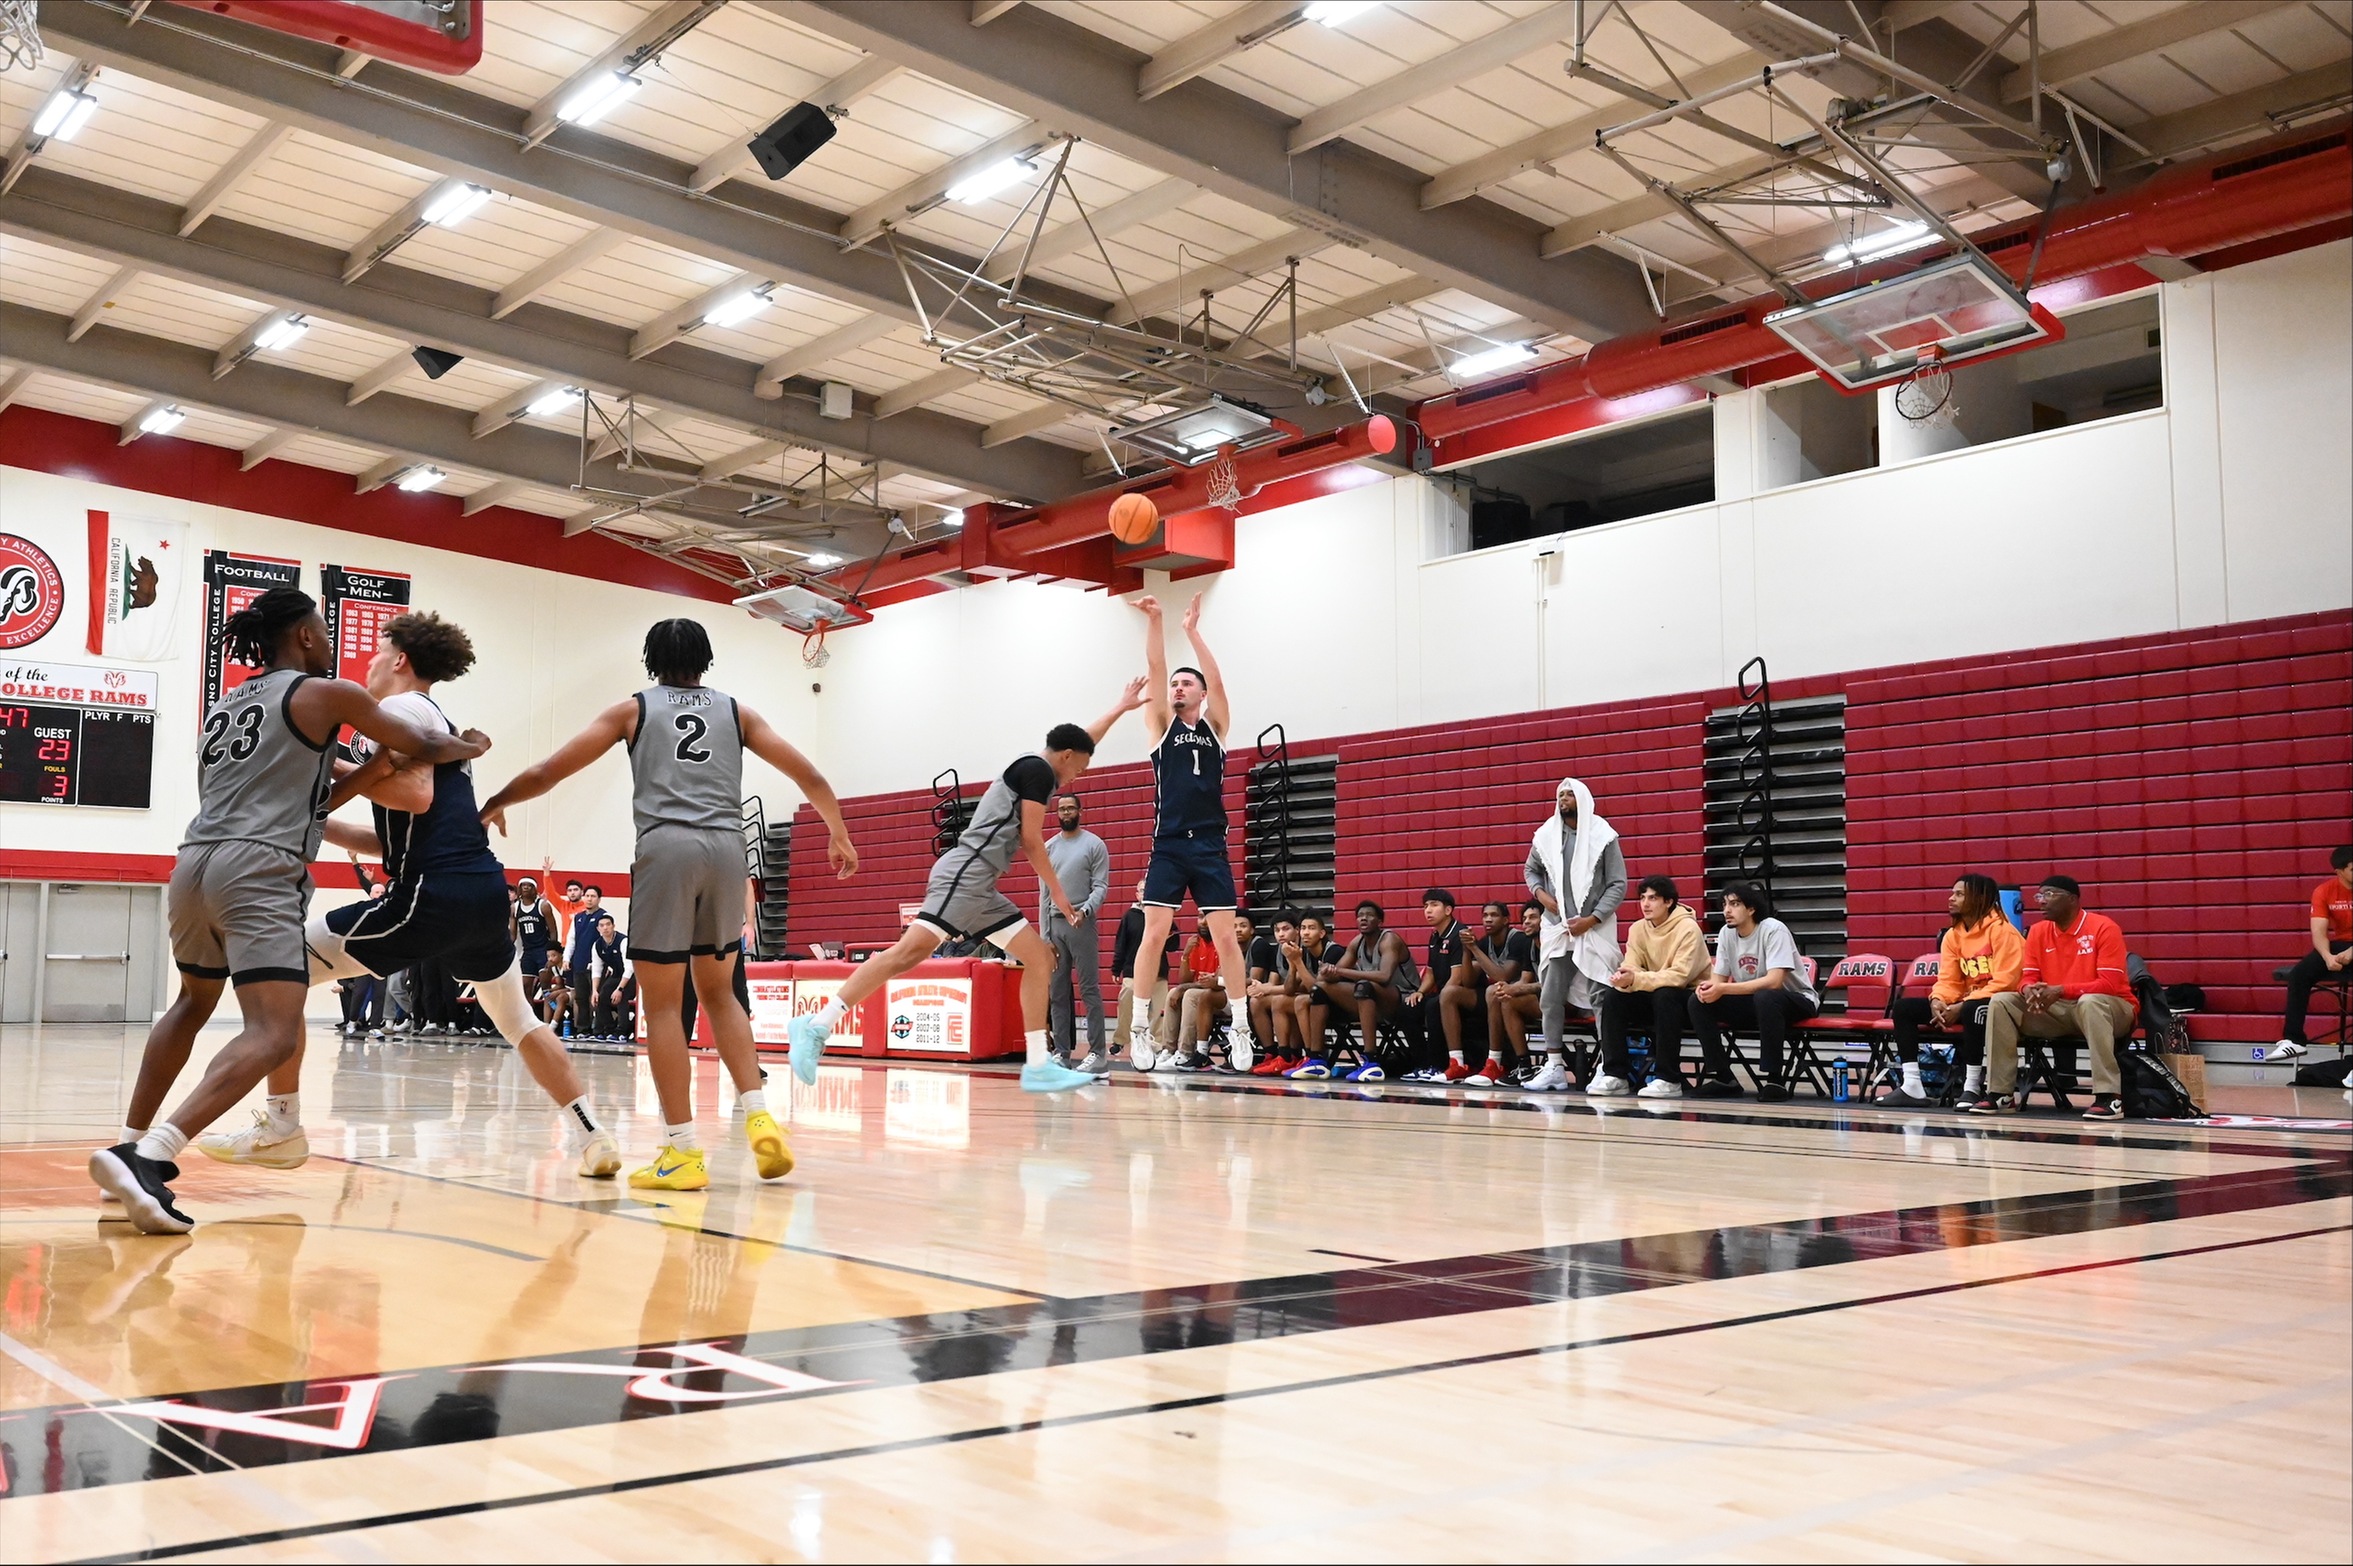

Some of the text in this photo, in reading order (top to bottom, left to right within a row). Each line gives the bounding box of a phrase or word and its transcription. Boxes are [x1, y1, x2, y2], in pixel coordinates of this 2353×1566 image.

[12, 541, 58, 587] ATHLETICS
[214, 563, 290, 582] FOOTBALL
[107, 537, 121, 625] CALIFORNIA REPUBLIC
[347, 575, 386, 588] GOLF
[349, 587, 382, 599] MEN
[354, 602, 398, 613] CONFERENCE
[6, 598, 59, 645] EXCELLENCE
[328, 601, 336, 648] OLLEGE
[208, 649, 218, 678] CITY
[5, 667, 48, 682] of the
[1, 683, 148, 706] OLLEGE RAMS
[666, 691, 713, 708] RAMS
[85, 711, 152, 724] PLYR F PTS
[34, 727, 72, 740] GUEST
[201, 702, 267, 770] 23
[673, 712, 710, 764] 2
[38, 738, 71, 762] 23
[44, 765, 67, 774] FOULS
[1191, 749, 1201, 776] 1
[53, 775, 69, 797] 3
[41, 796, 64, 805] POINTS
[523, 922, 536, 935] 10
[1837, 960, 1889, 978] RAMS
[1913, 960, 1939, 978] RA
